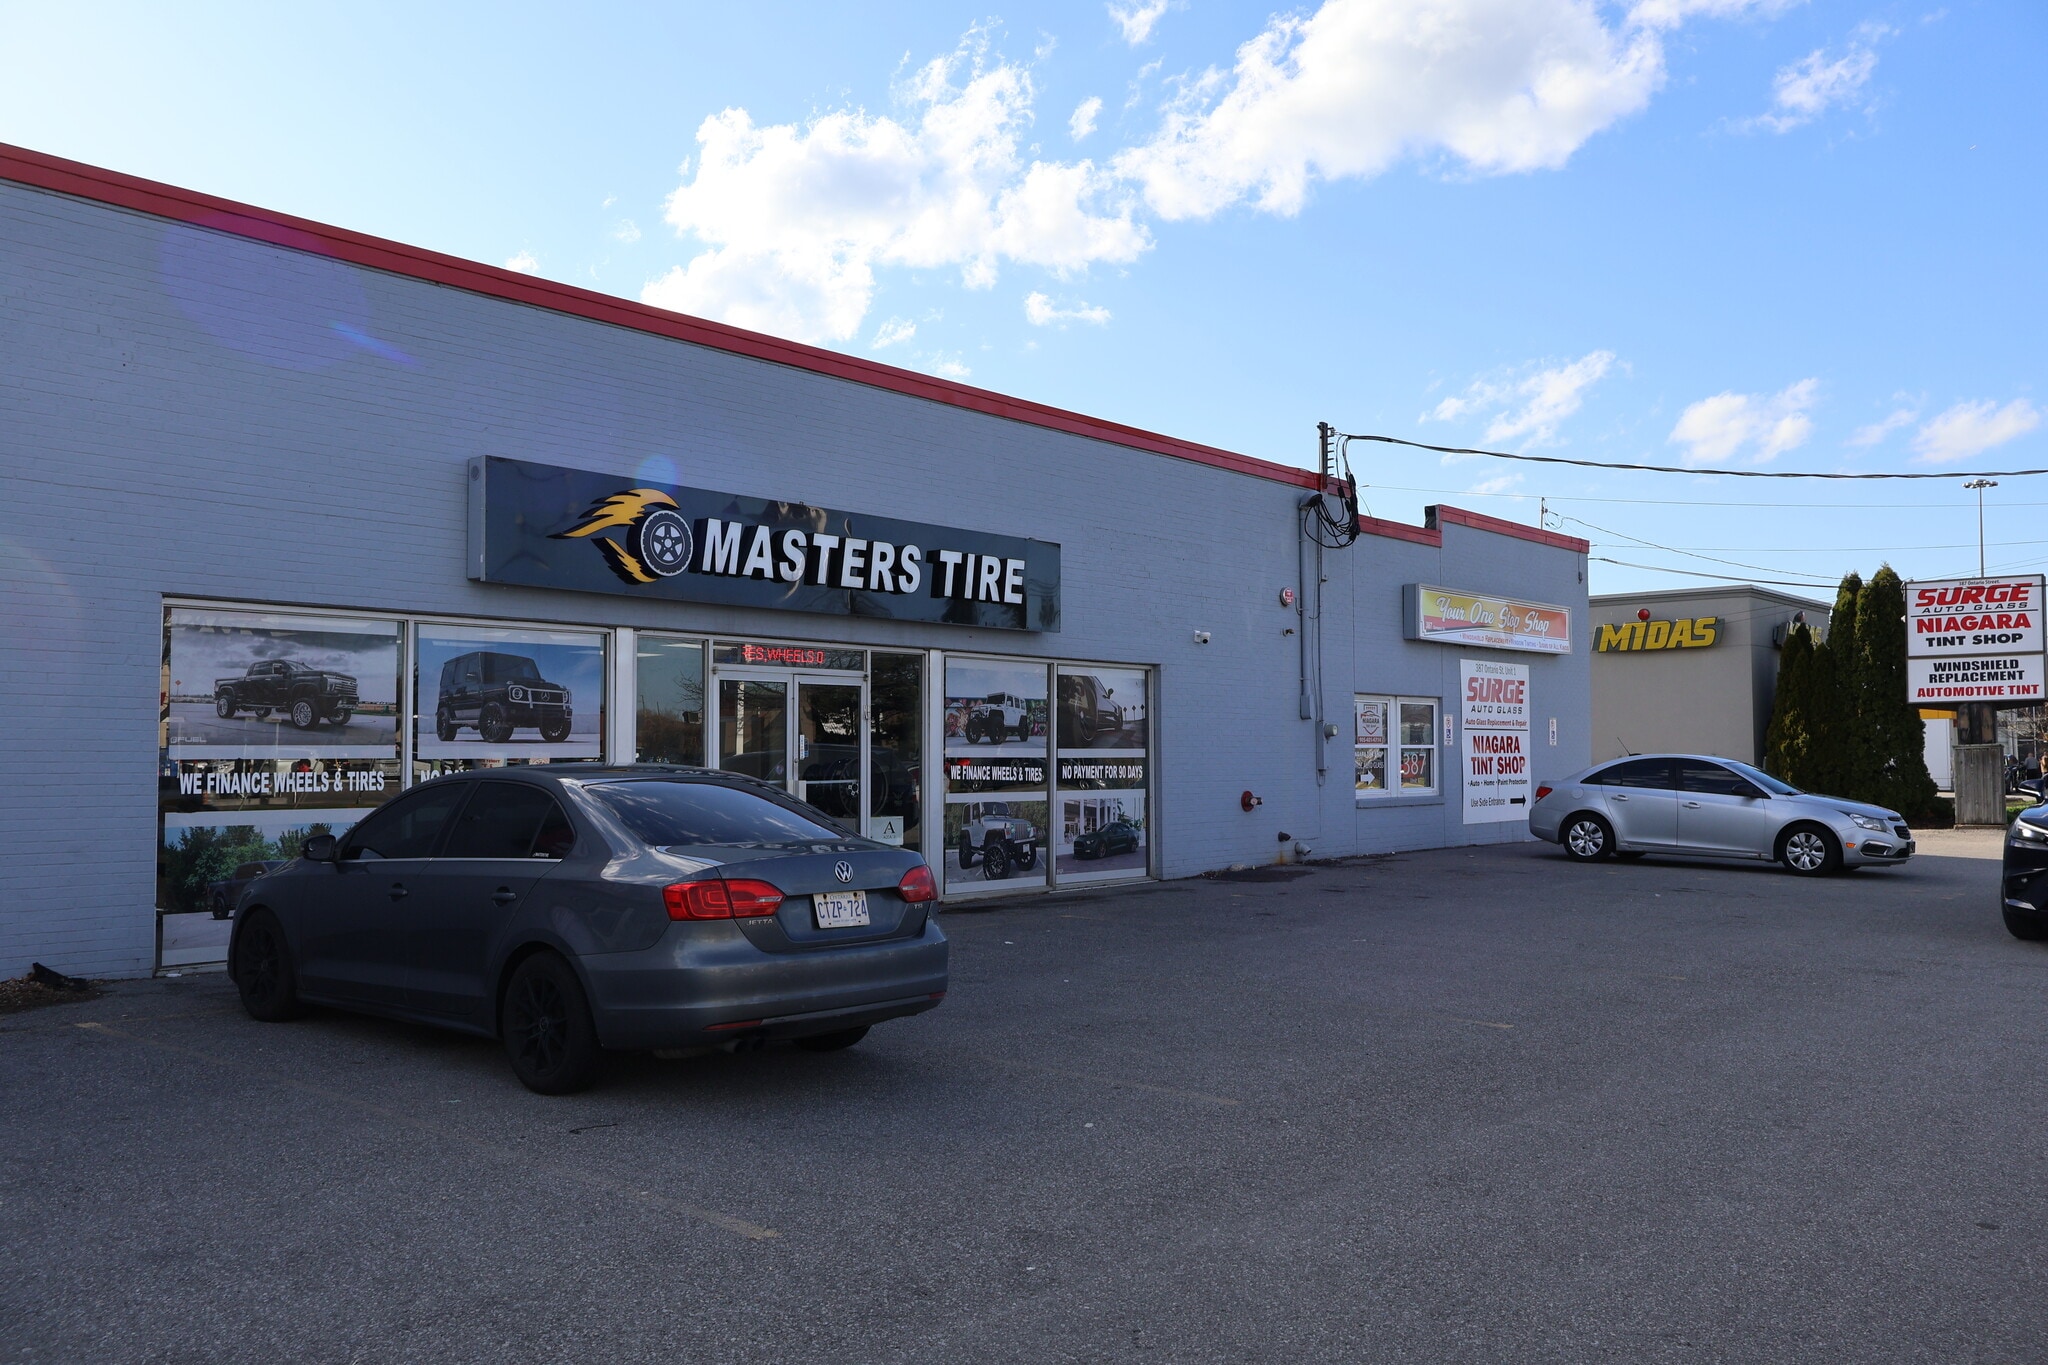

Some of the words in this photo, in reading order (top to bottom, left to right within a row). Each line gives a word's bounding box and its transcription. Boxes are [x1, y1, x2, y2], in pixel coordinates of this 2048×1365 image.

[702, 518, 922, 594] MASTERS
[938, 550, 1026, 604] TIRE
[1915, 583, 2033, 607] SURGE
[1922, 606, 1965, 614] AUTO
[1974, 602, 2028, 611] GLASS
[1436, 597, 1466, 622] Your
[1470, 602, 1494, 624] One
[1498, 606, 1520, 636] Stop
[1524, 611, 1550, 640] Shop
[1916, 613, 2032, 634] NIAGARA
[1598, 610, 1718, 652] MIDAS
[1926, 636, 1966, 647] TINT
[1972, 633, 2024, 645] SHOP
[1476, 664, 1484, 672] 387
[1484, 664, 1498, 674] Ontario
[1933, 659, 2019, 672] WINDSHIELD
[1929, 670, 2025, 684] REPLACEMENT
[1466, 677, 1526, 704] SURGE
[1917, 686, 2005, 698] AUTOMOTIVE
[2008, 684, 2040, 695] TINT
[1471, 704, 1493, 714] AUTO
[1496, 706, 1522, 714] GLASS
[1488, 719, 1512, 727] Replacement
[1516, 720, 1527, 728] Repair
[1473, 736, 1520, 754] NIAGARA
[1403, 753, 1426, 774] 387
[1471, 756, 1494, 775] TINT
[1497, 756, 1526, 774] SHOP
[950, 765, 960, 780] WE
[962, 765, 990, 780] FINANCE
[992, 766, 1018, 781] WHEELS
[1018, 767, 1024, 781] &
[1025, 767, 1042, 782] TIRES
[1062, 765, 1072, 779] NO
[1074, 765, 1104, 779] PAYMENT
[1105, 765, 1118, 778] FOR
[1118, 765, 1126, 778] 90
[1128, 765, 1143, 778] DAYS
[180, 772, 202, 794] WE
[207, 772, 270, 794] FINANCE
[274, 771, 330, 792] WHEELS
[334, 771, 344, 792] &
[347, 770, 385, 792] TIRES
[1470, 798, 1479, 808] Use
[1479, 798, 1488, 807] Side
[1488, 797, 1506, 806] Entrance
[884, 821, 896, 834] A
[747, 918, 773, 926] JETTA
